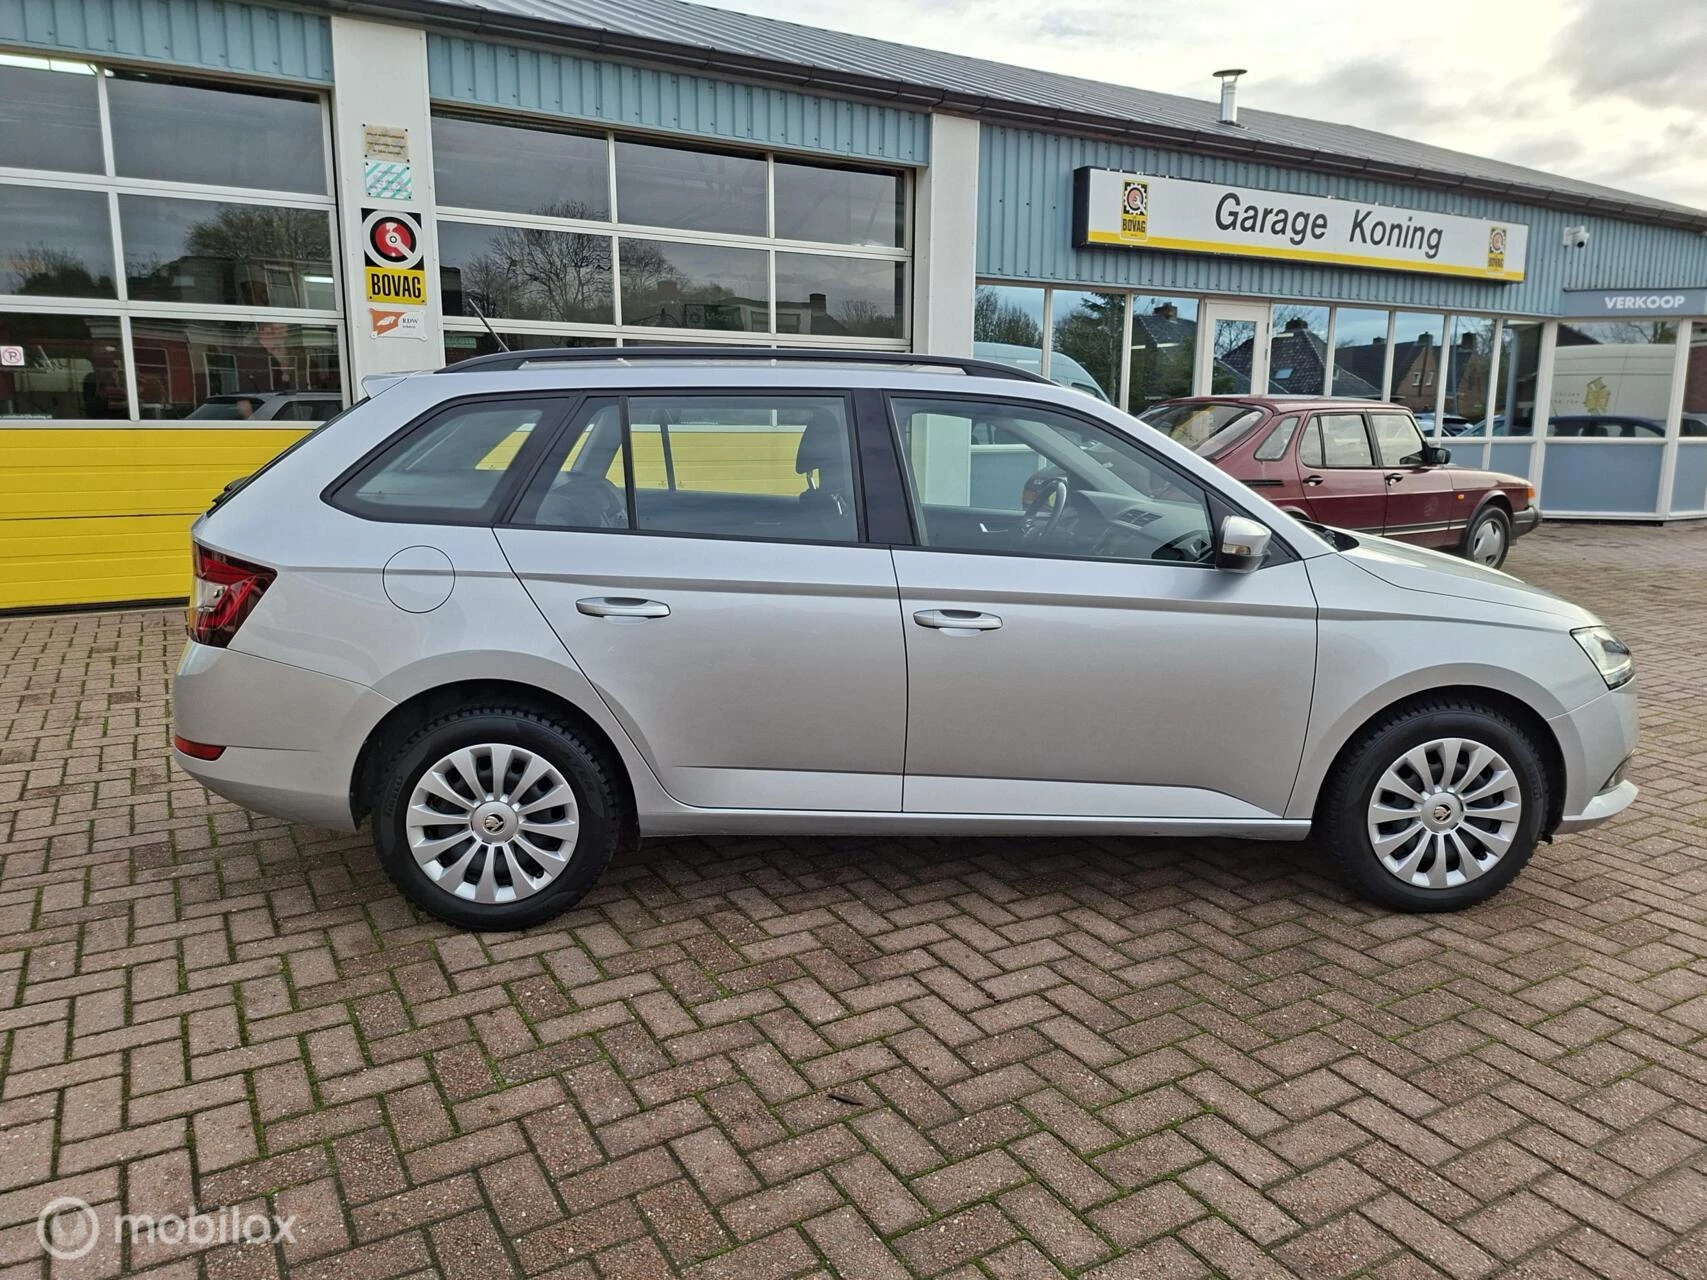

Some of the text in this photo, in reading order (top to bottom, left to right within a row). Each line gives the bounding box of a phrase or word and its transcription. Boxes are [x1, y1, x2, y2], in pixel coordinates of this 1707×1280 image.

[1122, 218, 1146, 233] BOVAG
[1215, 192, 1443, 259] Garage Koning
[371, 273, 422, 299] BOVAG
[1604, 295, 1685, 309] VERKOOP
